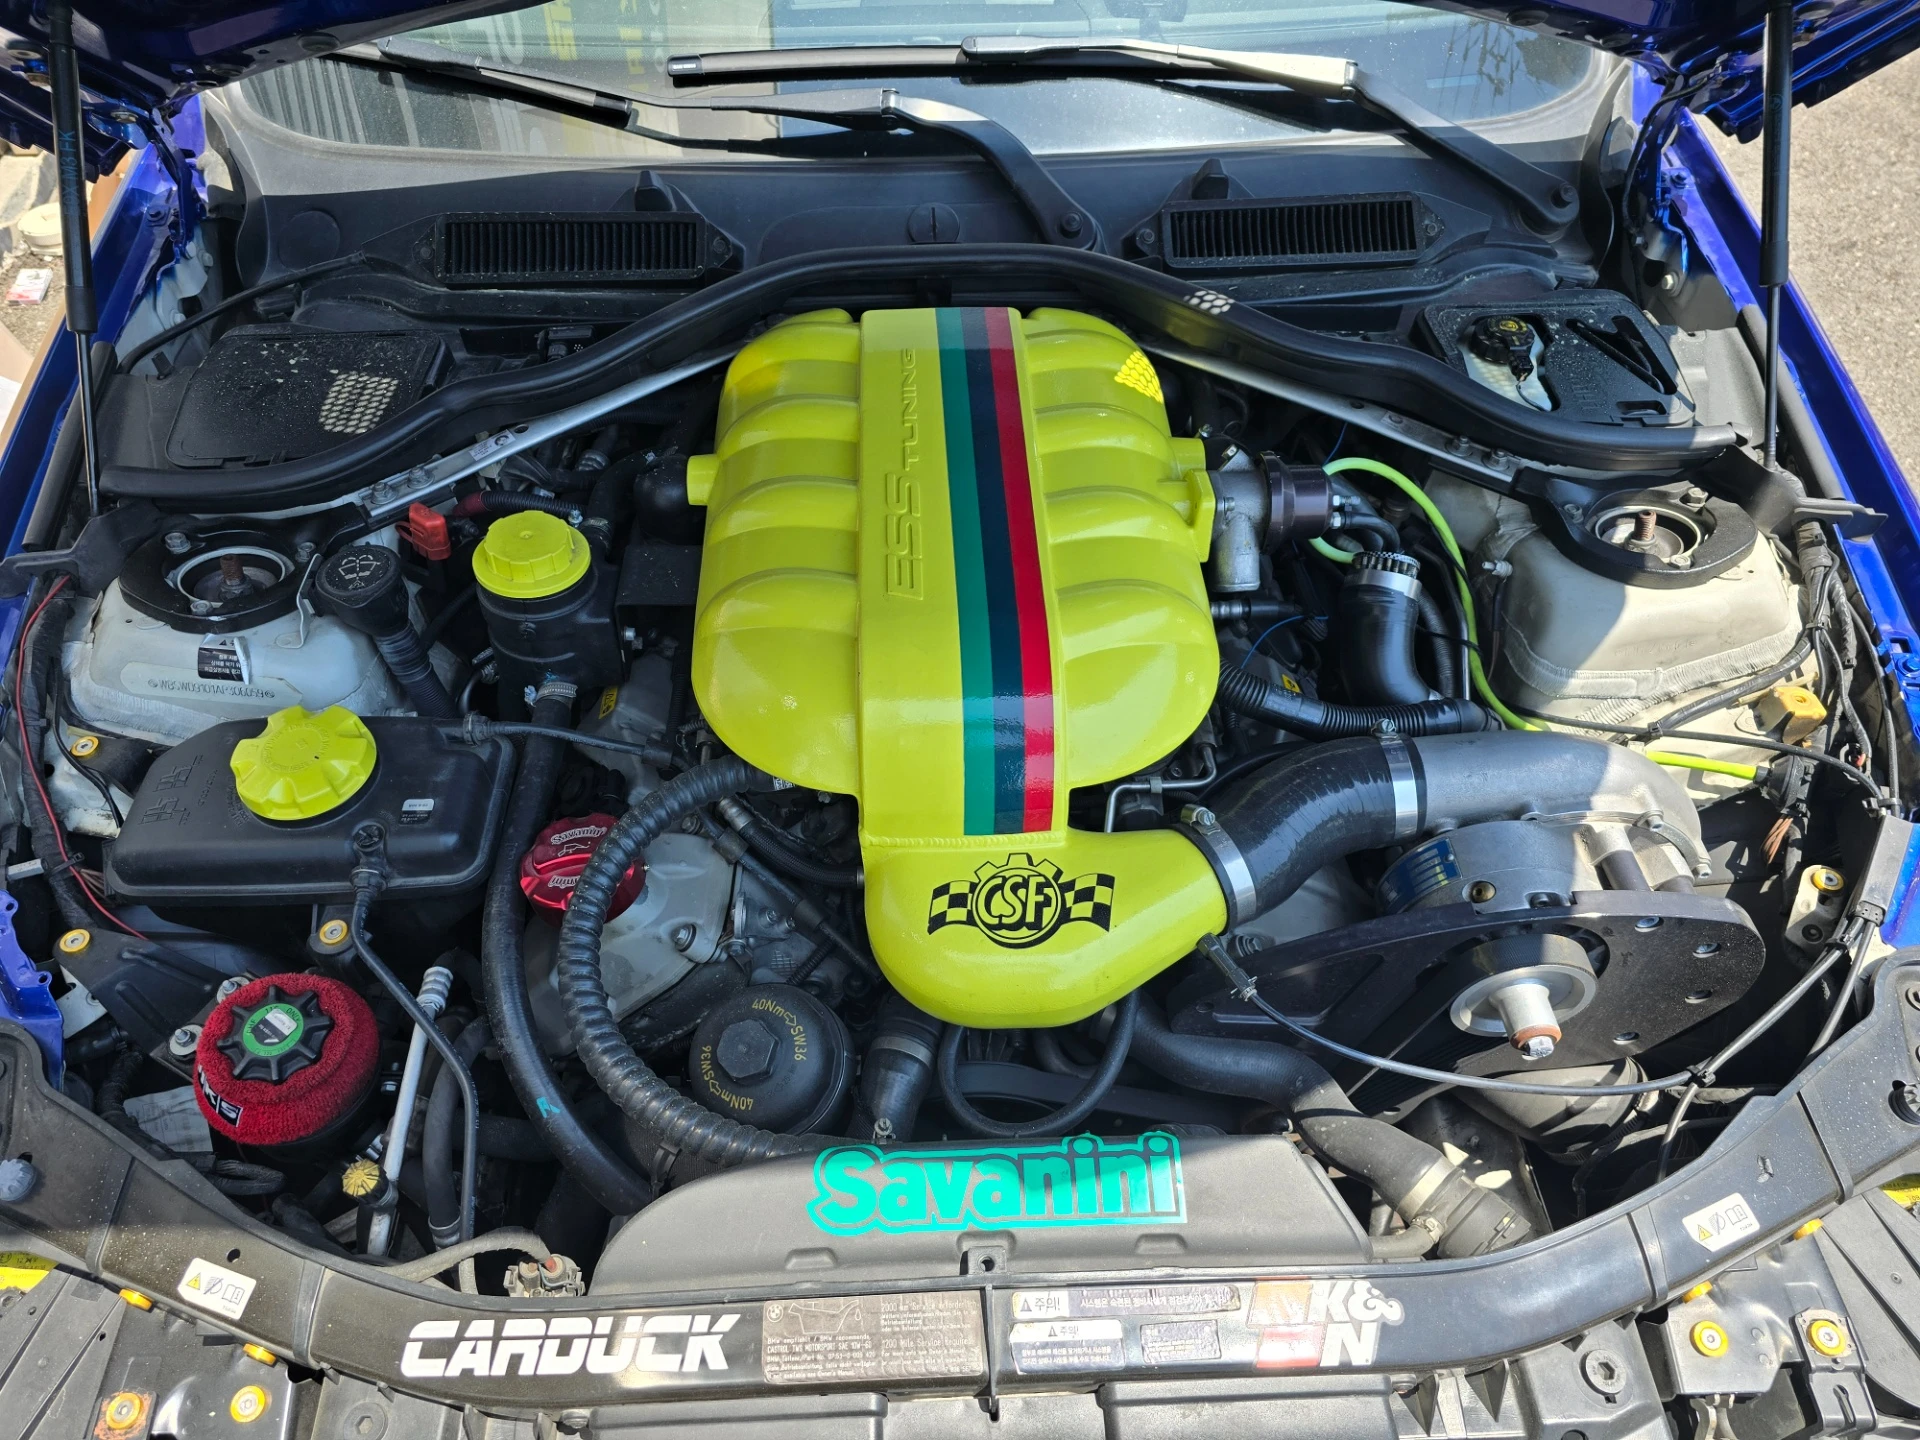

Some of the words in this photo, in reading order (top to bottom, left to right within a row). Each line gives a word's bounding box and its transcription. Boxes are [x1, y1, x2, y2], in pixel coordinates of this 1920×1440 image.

[59, 129, 76, 152] FK
[61, 156, 78, 180] M3
[901, 348, 920, 472] TUNING
[885, 472, 924, 601] ESS
[976, 874, 1048, 931] CSF
[752, 998, 785, 1018] 40Nm
[790, 1024, 808, 1061] SW36
[700, 1045, 715, 1081] SW36
[720, 1089, 754, 1111] 40Nm
[820, 1136, 1177, 1225] Savanini
[1034, 1296, 1061, 1312] 주의!
[400, 1313, 742, 1378] CARDUCK
[917, 1337, 941, 1347] Service
[1060, 1325, 1079, 1337] 주의!
[767, 1345, 789, 1354] CASTROL
[804, 1342, 836, 1352] MOTORSPORT
[838, 1342, 849, 1350] SAE
